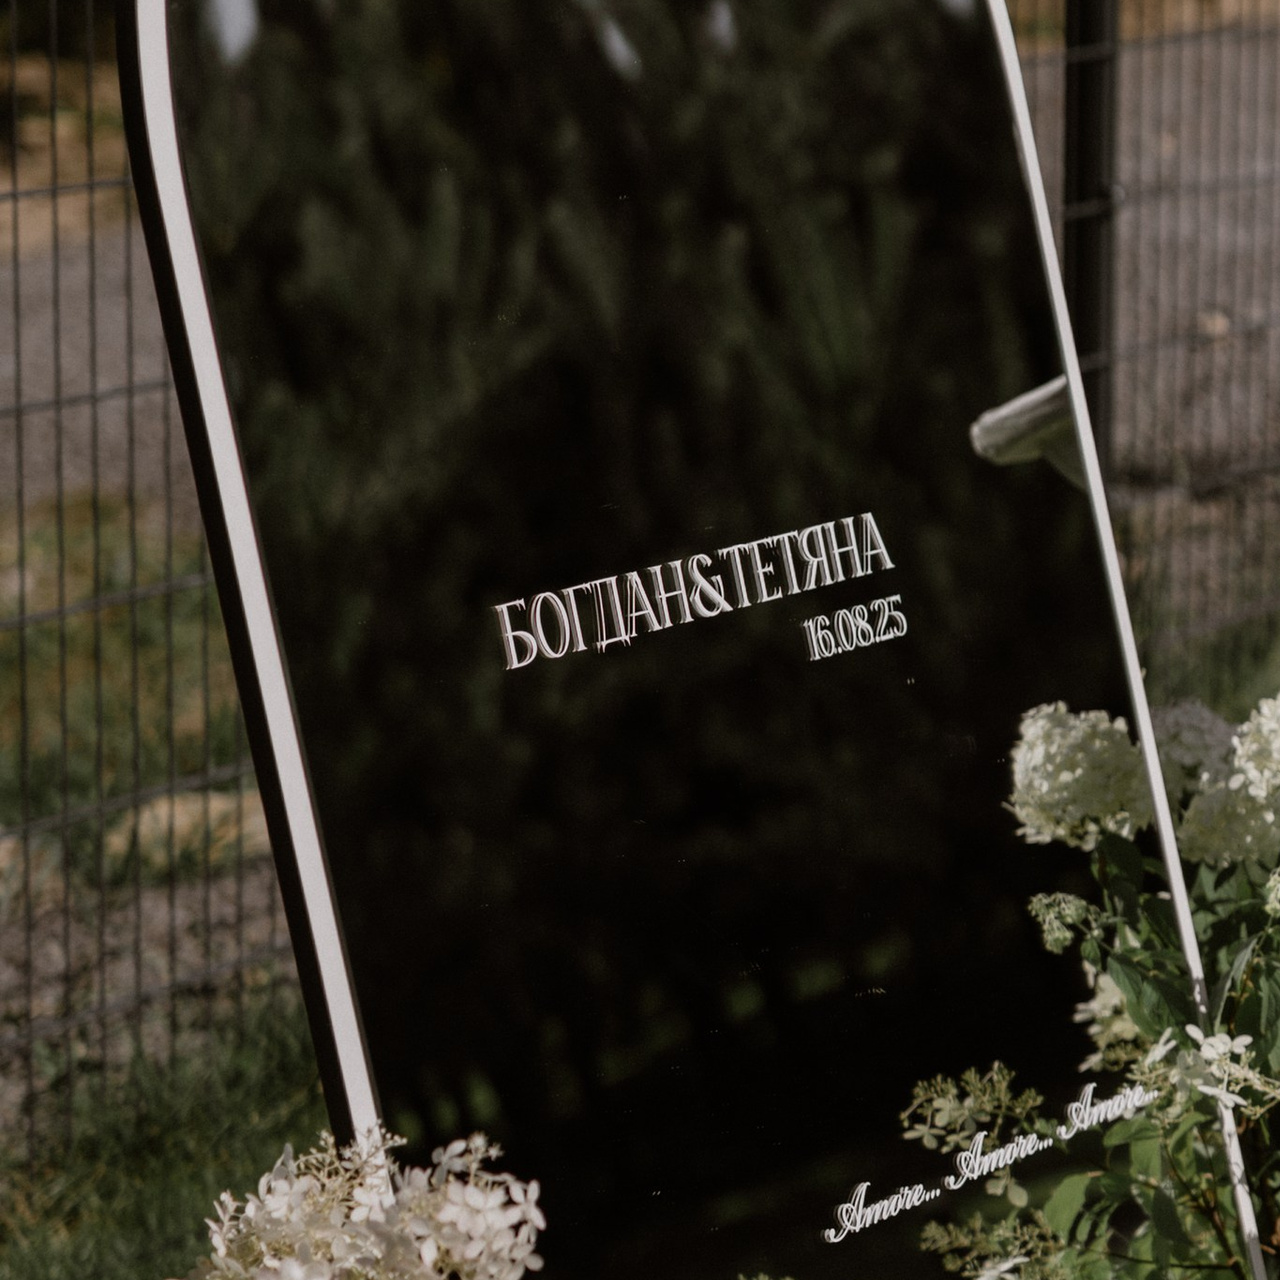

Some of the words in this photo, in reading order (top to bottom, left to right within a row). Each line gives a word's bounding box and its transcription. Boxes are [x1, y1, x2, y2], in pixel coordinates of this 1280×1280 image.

[802, 594, 908, 662] 16.08.25
[820, 1181, 941, 1244] Amore...
[942, 1130, 1053, 1191] Amore...
